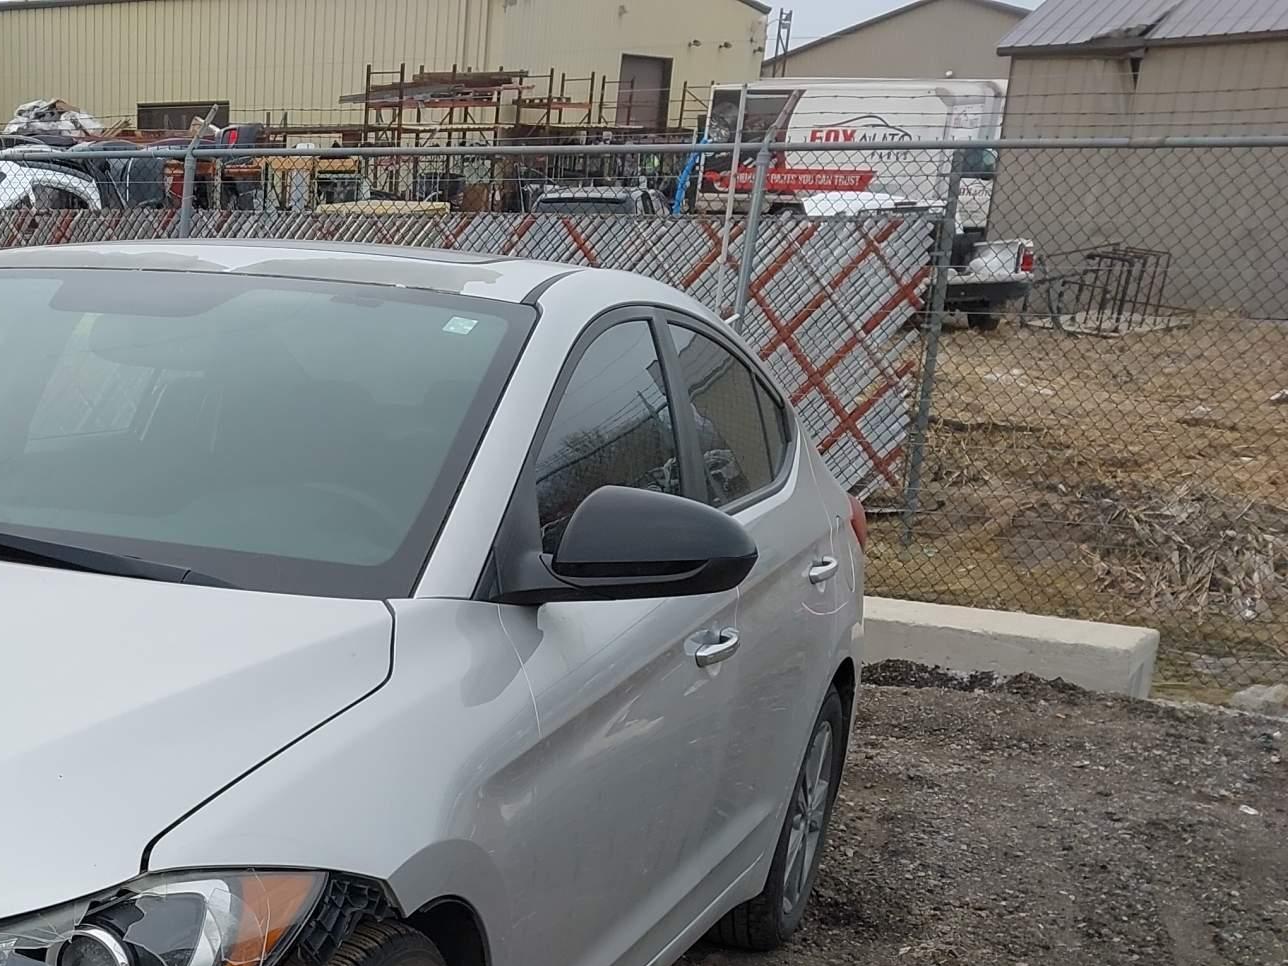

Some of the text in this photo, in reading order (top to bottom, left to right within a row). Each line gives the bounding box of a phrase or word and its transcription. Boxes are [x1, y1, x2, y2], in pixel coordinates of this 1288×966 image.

[770, 173, 797, 185] PARTS
[798, 174, 813, 185] YOU
[815, 174, 832, 185] CAN
[834, 175, 861, 186] TRUST
